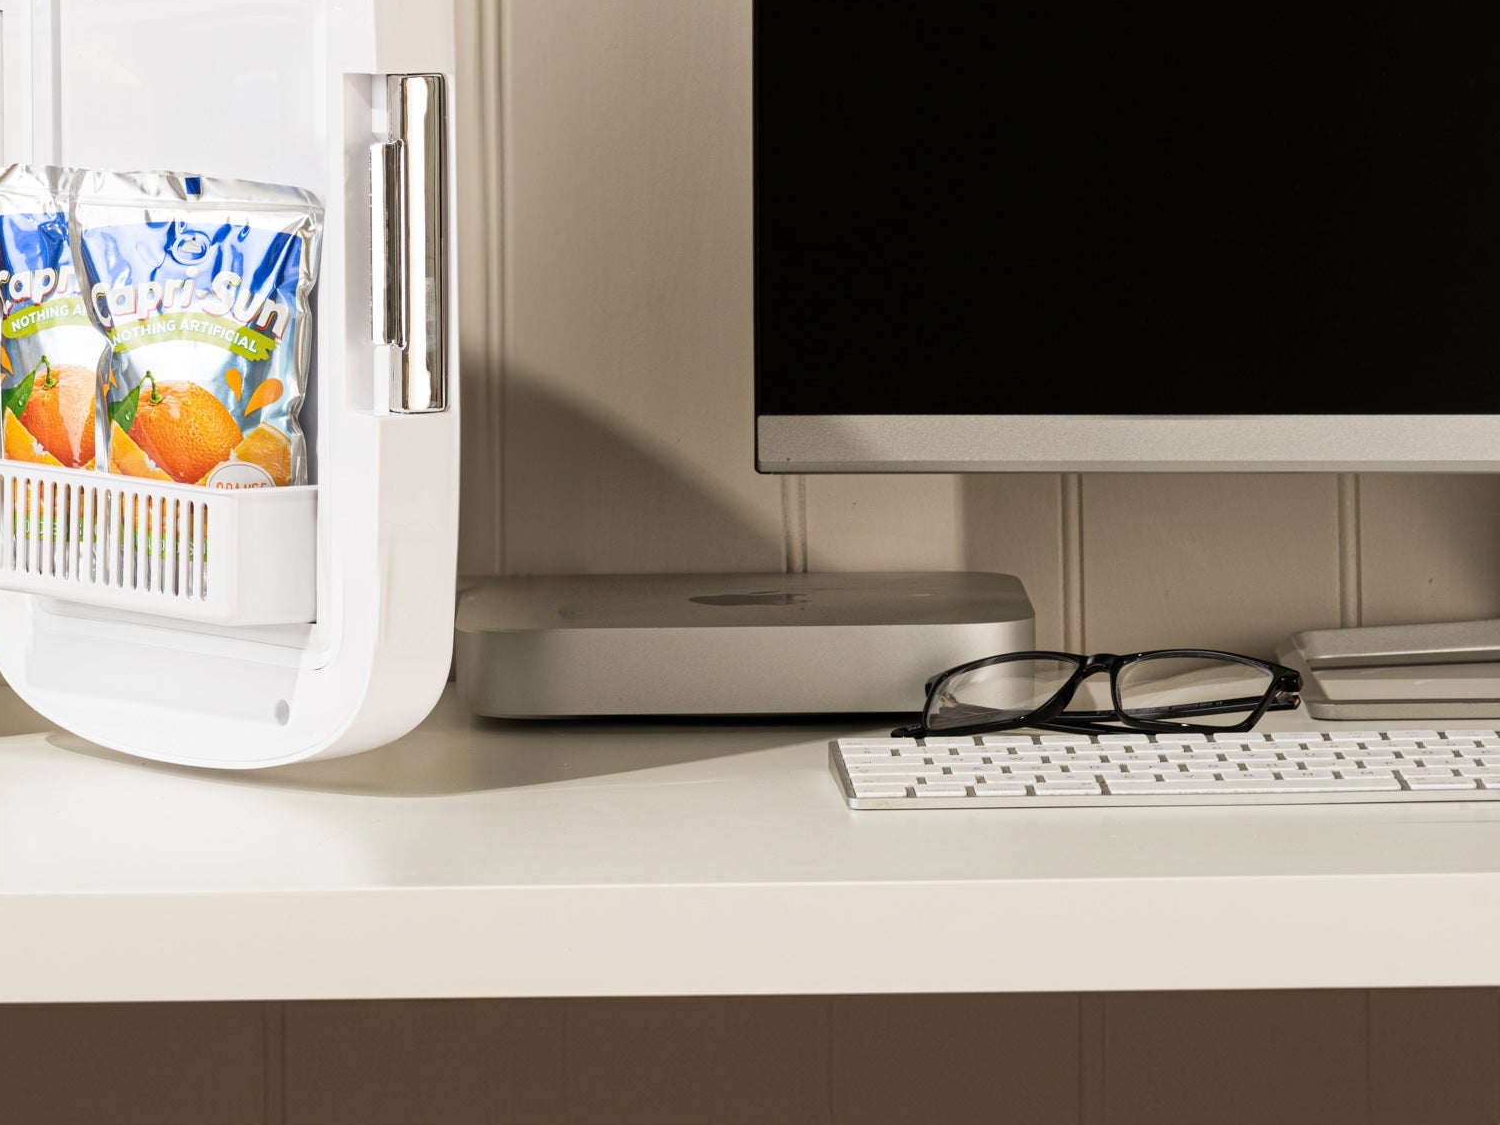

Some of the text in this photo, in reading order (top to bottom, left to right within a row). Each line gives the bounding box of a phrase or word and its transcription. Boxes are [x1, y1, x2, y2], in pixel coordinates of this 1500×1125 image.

[11, 305, 70, 333] NOTHING
[111, 319, 258, 354] NOTHING ARTIFICIAL
